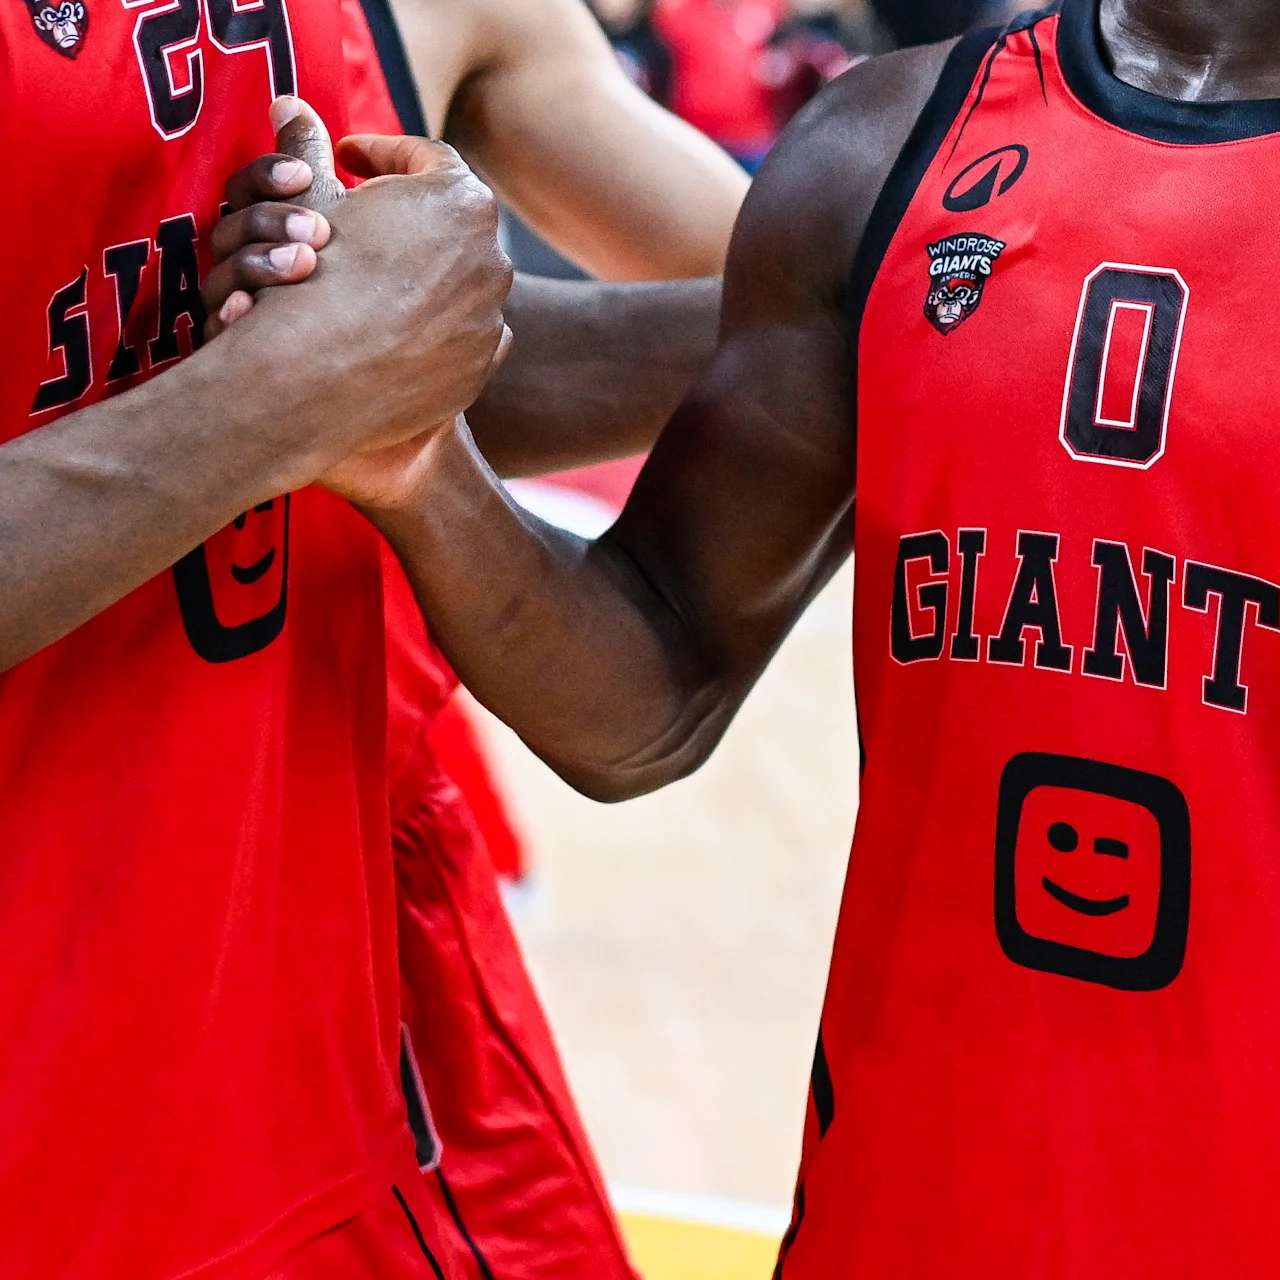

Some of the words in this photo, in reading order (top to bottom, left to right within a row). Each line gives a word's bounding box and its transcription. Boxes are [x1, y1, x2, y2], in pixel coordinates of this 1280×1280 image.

[929, 237, 1004, 257] WINDROSE
[929, 254, 992, 276] GIANTS
[1058, 261, 1190, 470] 0
